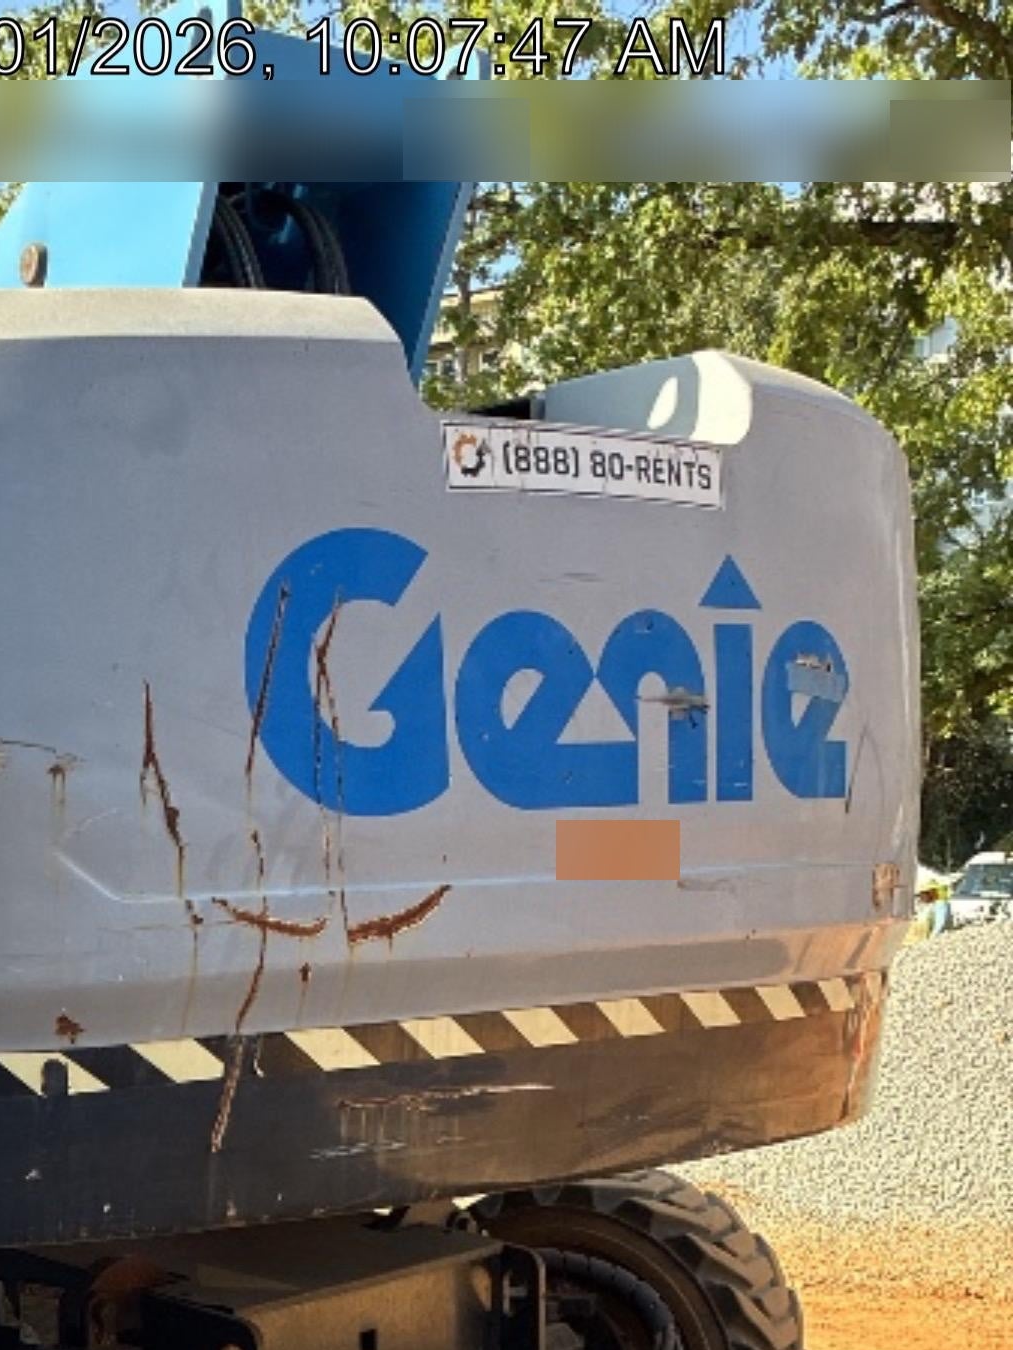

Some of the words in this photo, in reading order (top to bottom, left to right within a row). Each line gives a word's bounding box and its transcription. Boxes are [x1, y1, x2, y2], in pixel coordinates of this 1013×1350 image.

[502, 440, 580, 478] (888)
[589, 449, 712, 490] 80-RENTS
[244, 526, 850, 818] Genie
